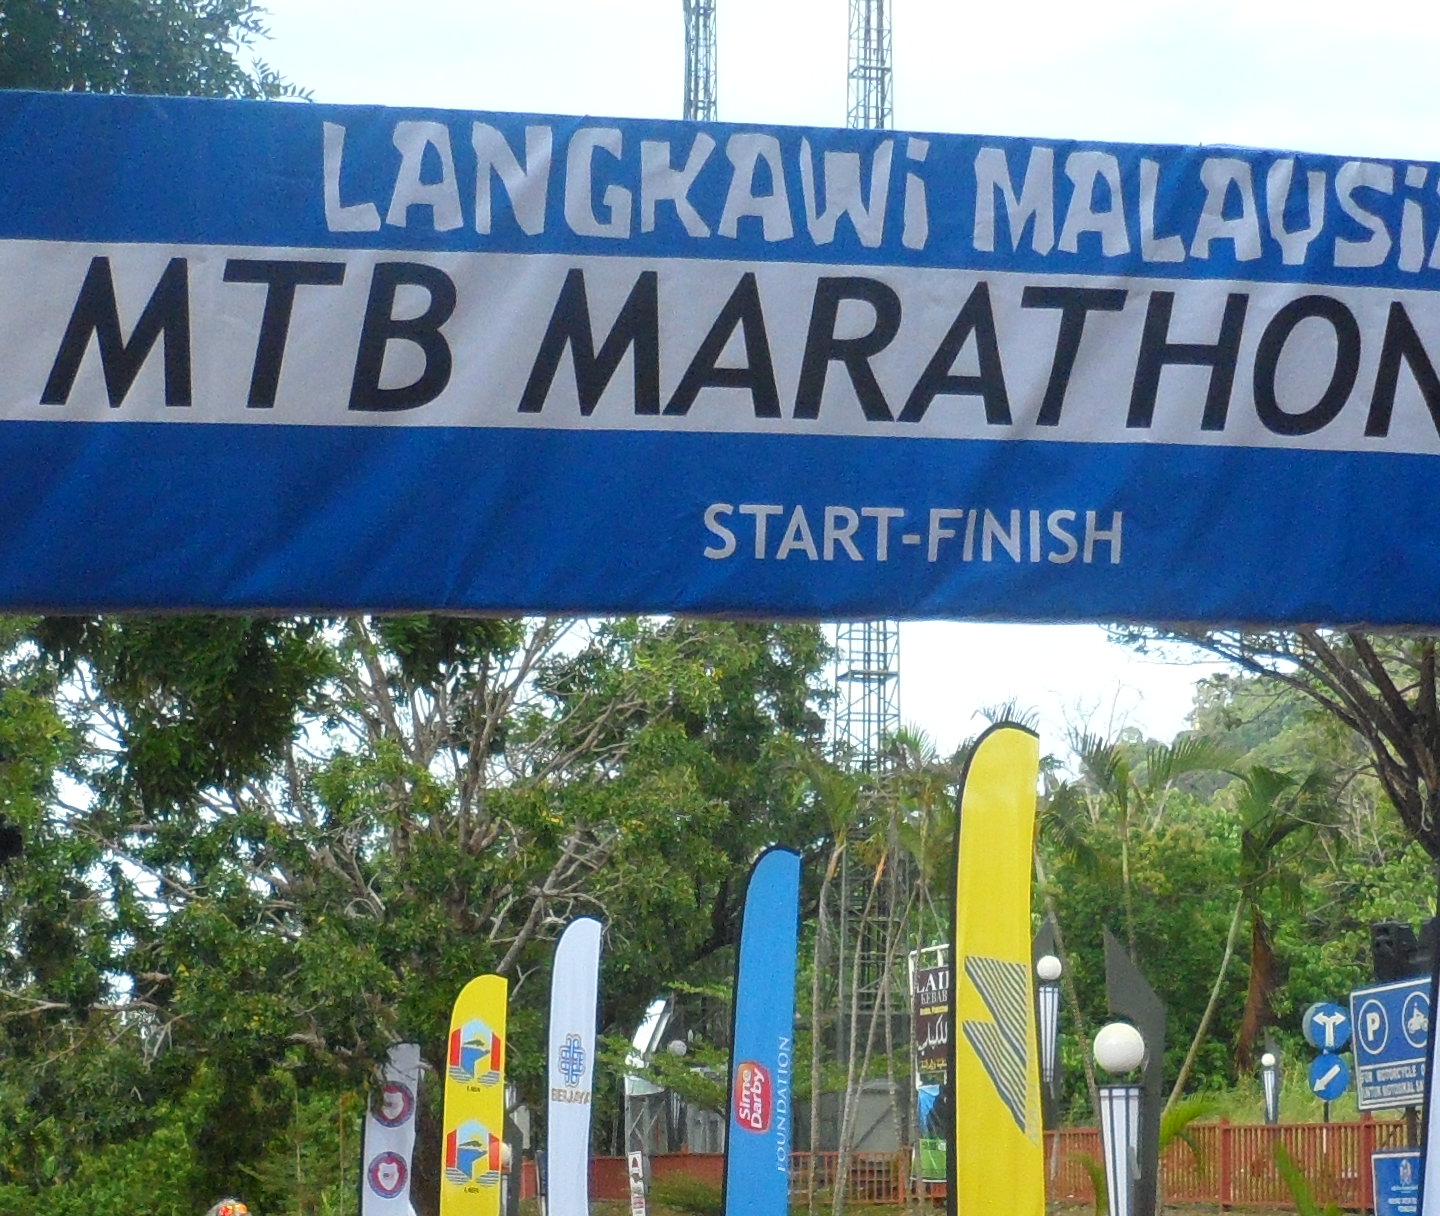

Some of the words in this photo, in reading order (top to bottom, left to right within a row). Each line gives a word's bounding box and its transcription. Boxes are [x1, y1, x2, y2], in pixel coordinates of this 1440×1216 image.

[40, 255, 459, 413] MTB
[703, 502, 1124, 565] START-FINISH
[1366, 1011, 1381, 1042] P
[739, 1069, 752, 1121] Sime
[751, 1067, 765, 1129] Darby
